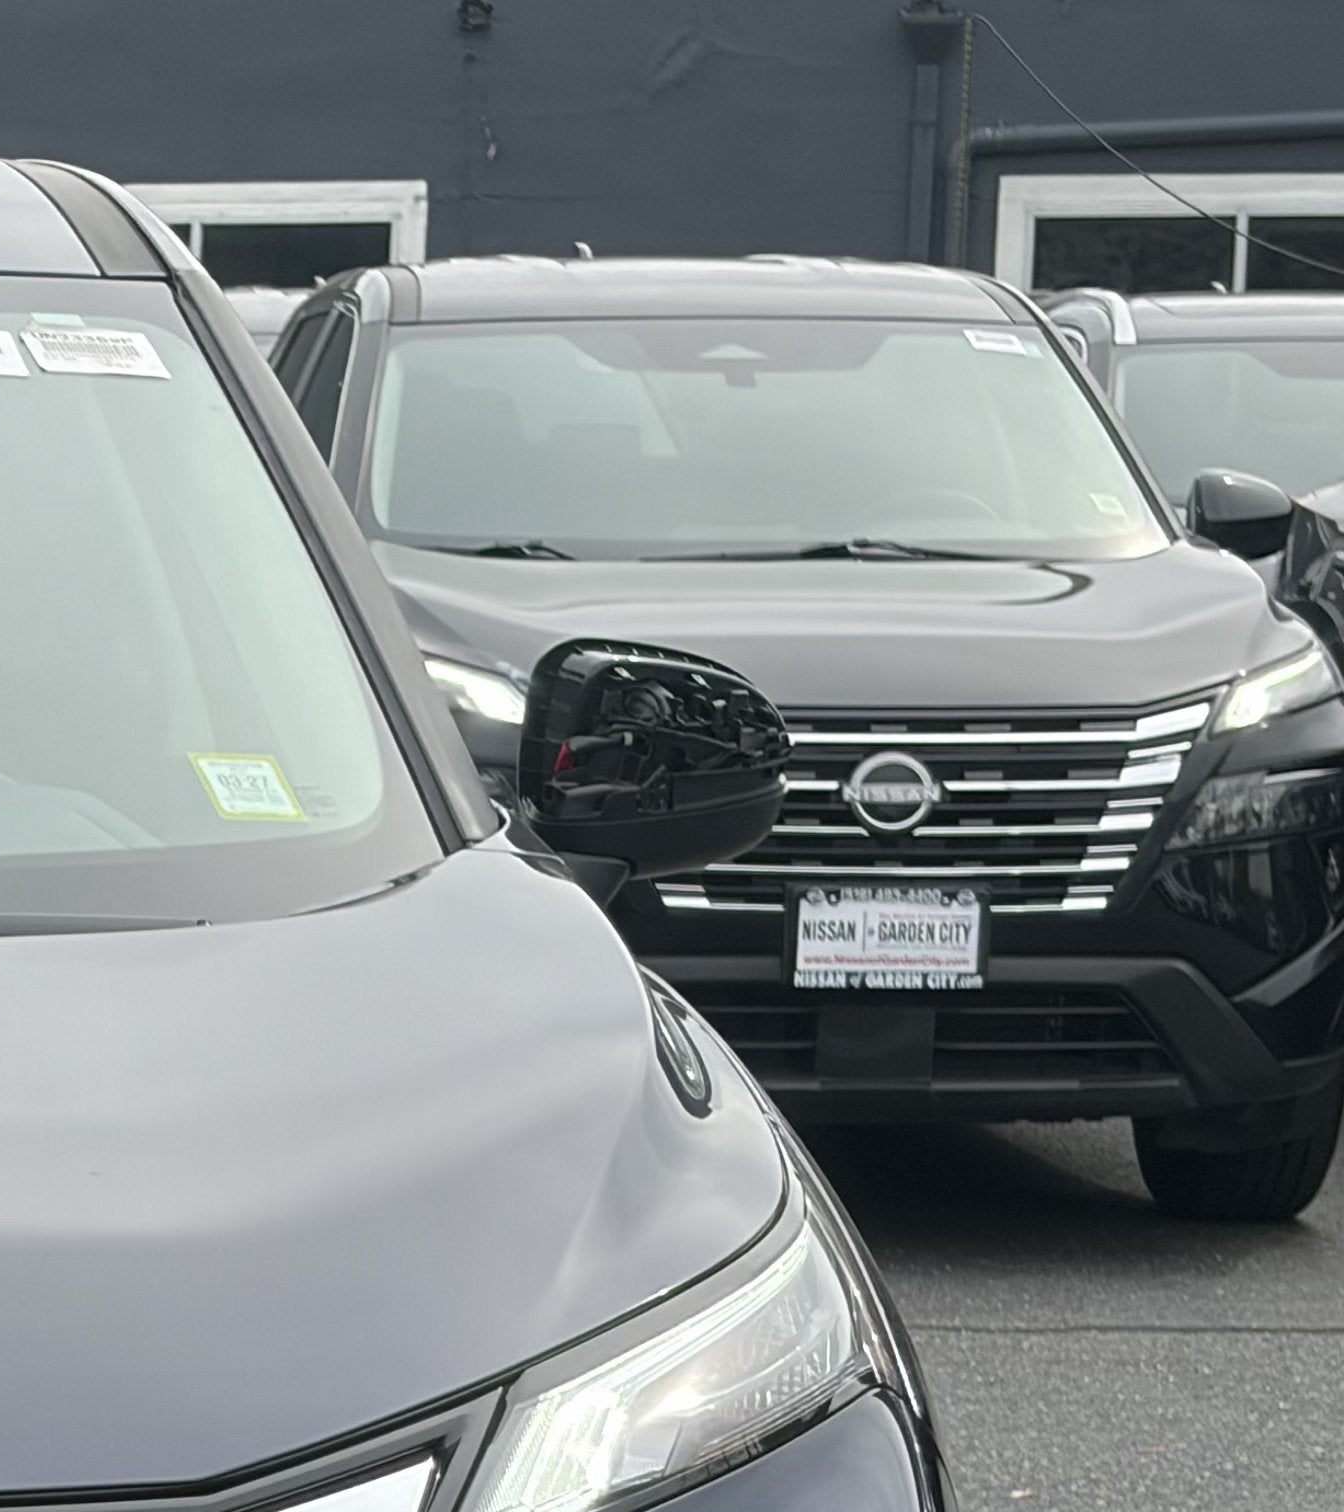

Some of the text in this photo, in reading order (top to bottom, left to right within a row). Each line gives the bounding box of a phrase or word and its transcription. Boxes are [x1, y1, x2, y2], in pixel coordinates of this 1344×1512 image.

[844, 786, 941, 802] NISSAN
[803, 920, 856, 941] NISSAN
[879, 921, 935, 942] GARDEN
[939, 922, 971, 944] CITY
[794, 971, 846, 988] NISSAN
[865, 972, 924, 989] GARDEN
